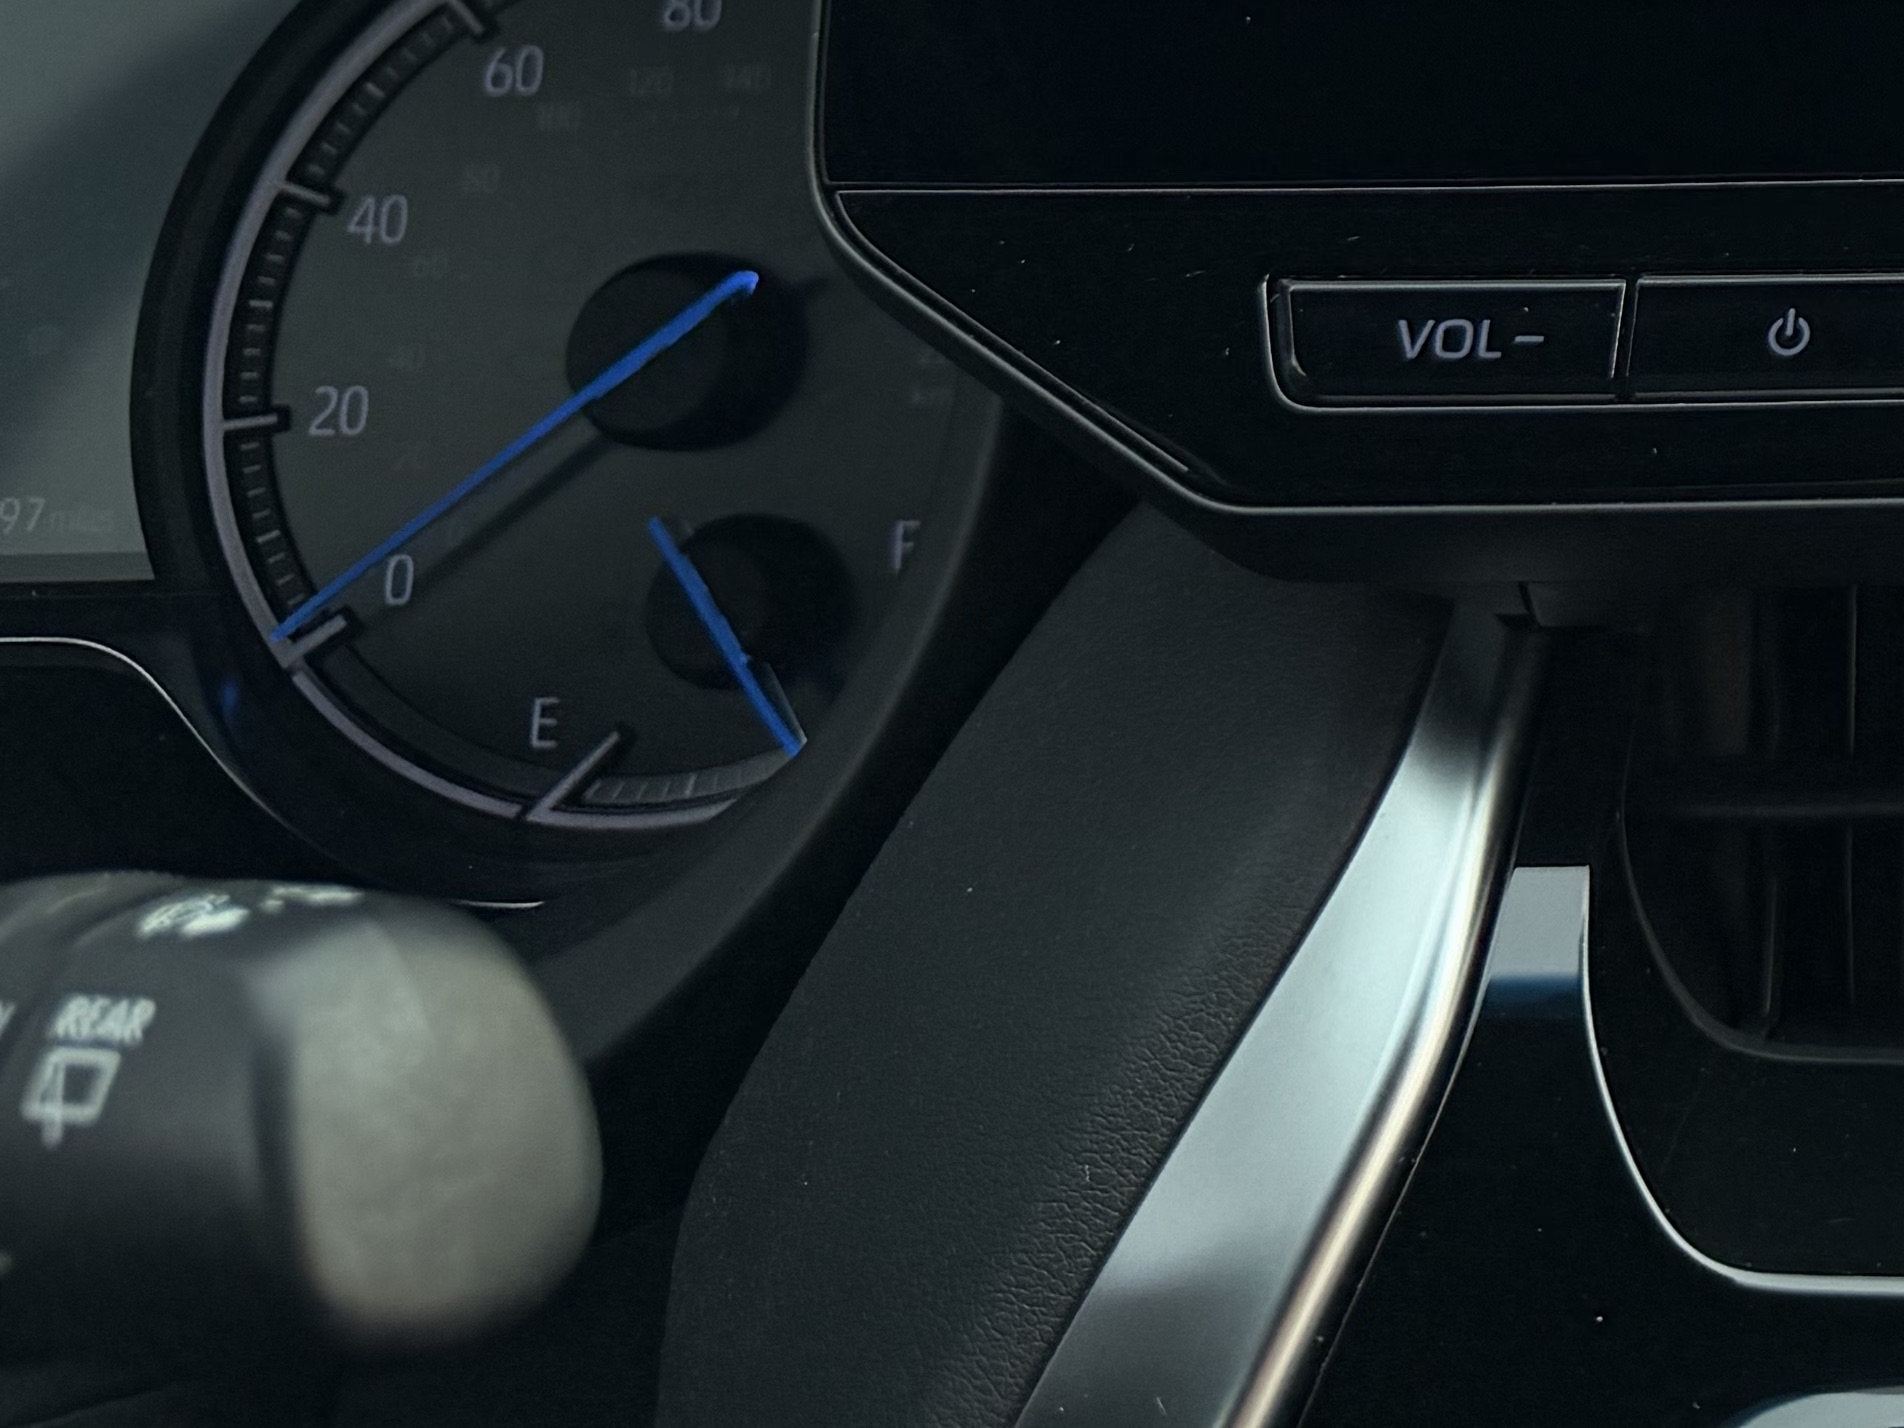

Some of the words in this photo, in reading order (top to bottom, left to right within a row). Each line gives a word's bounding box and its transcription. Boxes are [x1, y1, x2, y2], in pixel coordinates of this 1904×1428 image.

[484, 46, 543, 96] 60
[347, 196, 407, 244] 40
[308, 386, 368, 436] 20
[893, 520, 919, 570] F
[385, 554, 414, 604] 0
[531, 698, 557, 748] E
[54, 996, 157, 1043] REAR
